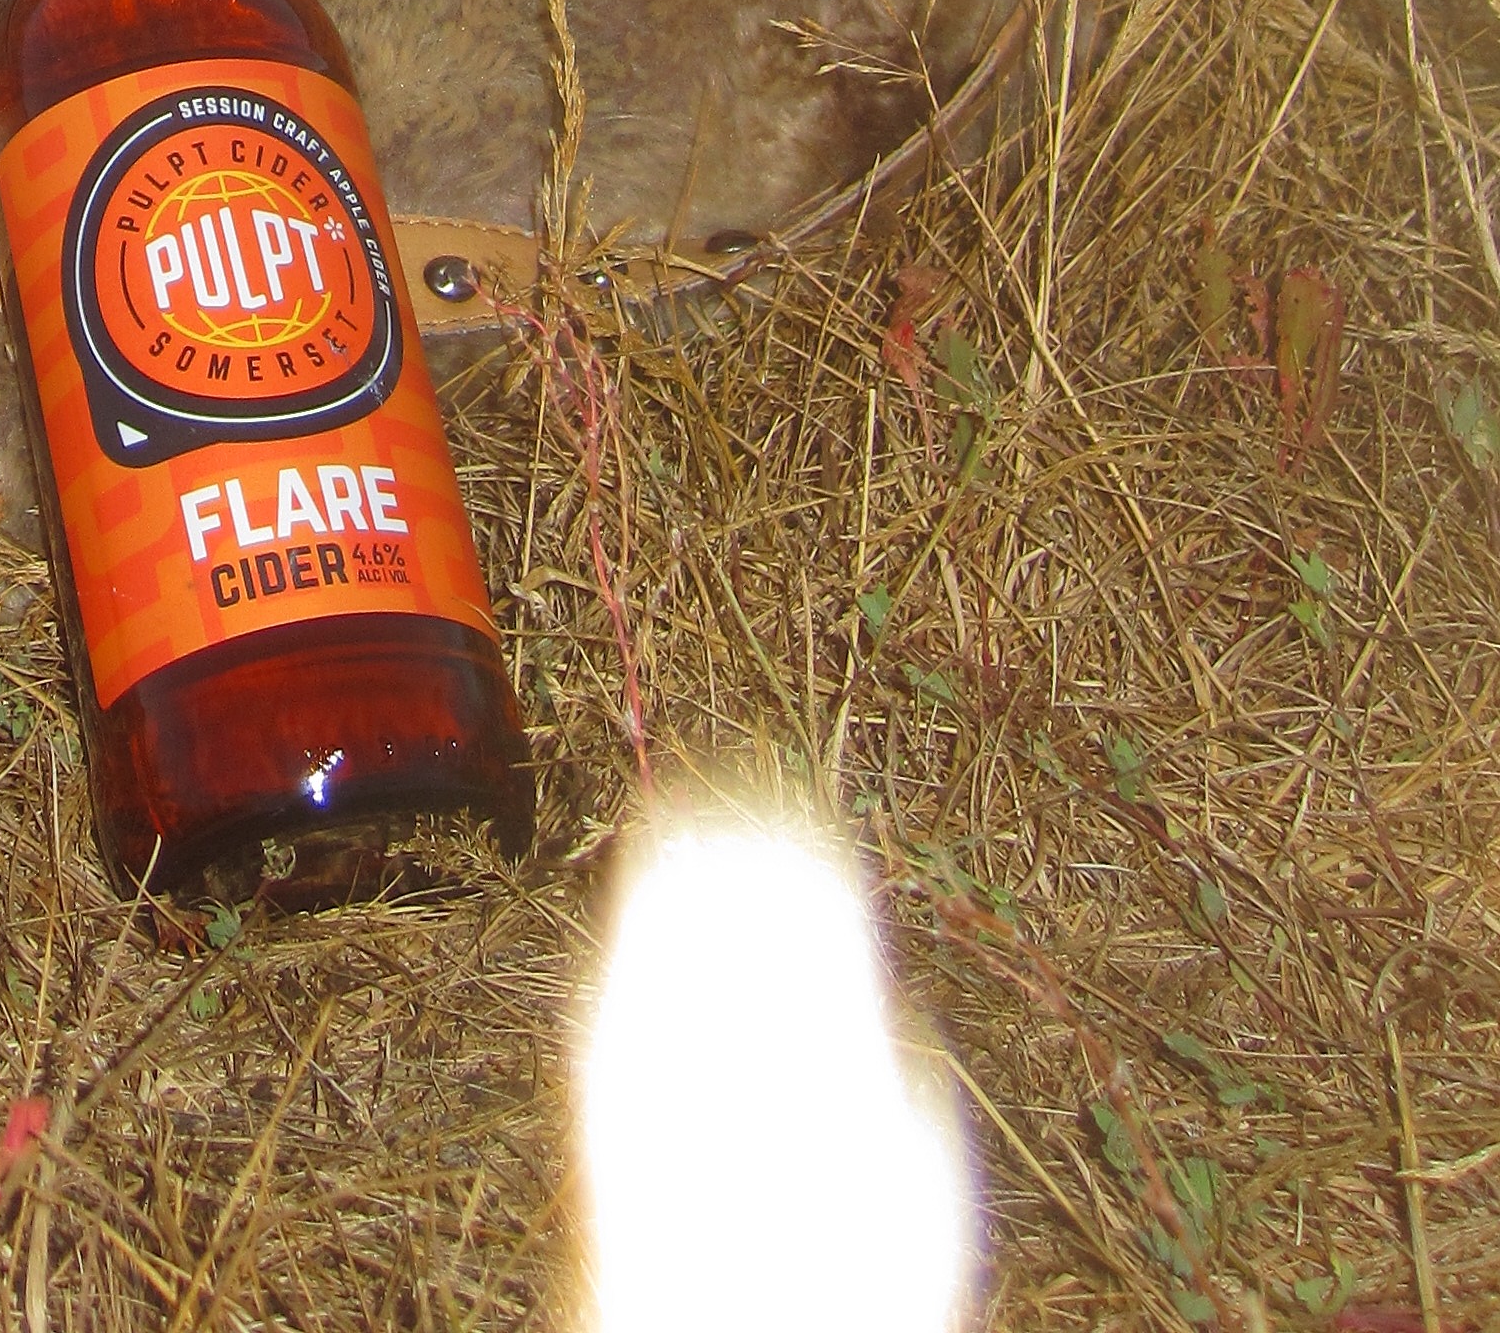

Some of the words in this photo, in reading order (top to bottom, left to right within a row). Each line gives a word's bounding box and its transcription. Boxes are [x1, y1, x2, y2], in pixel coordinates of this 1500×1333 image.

[117, 142, 208, 232] PULPT
[231, 140, 330, 212] CIDER
[178, 97, 265, 122] SESSION
[273, 113, 329, 162] CRAFT
[329, 169, 369, 230] APPLE
[366, 238, 390, 296] CIDER
[145, 207, 324, 309] PULPT
[148, 311, 357, 381] SOMERSET
[180, 465, 409, 561] FLARE
[211, 543, 349, 608] CIDER
[352, 543, 405, 566] 4.6%
[358, 569, 381, 583] ALC
